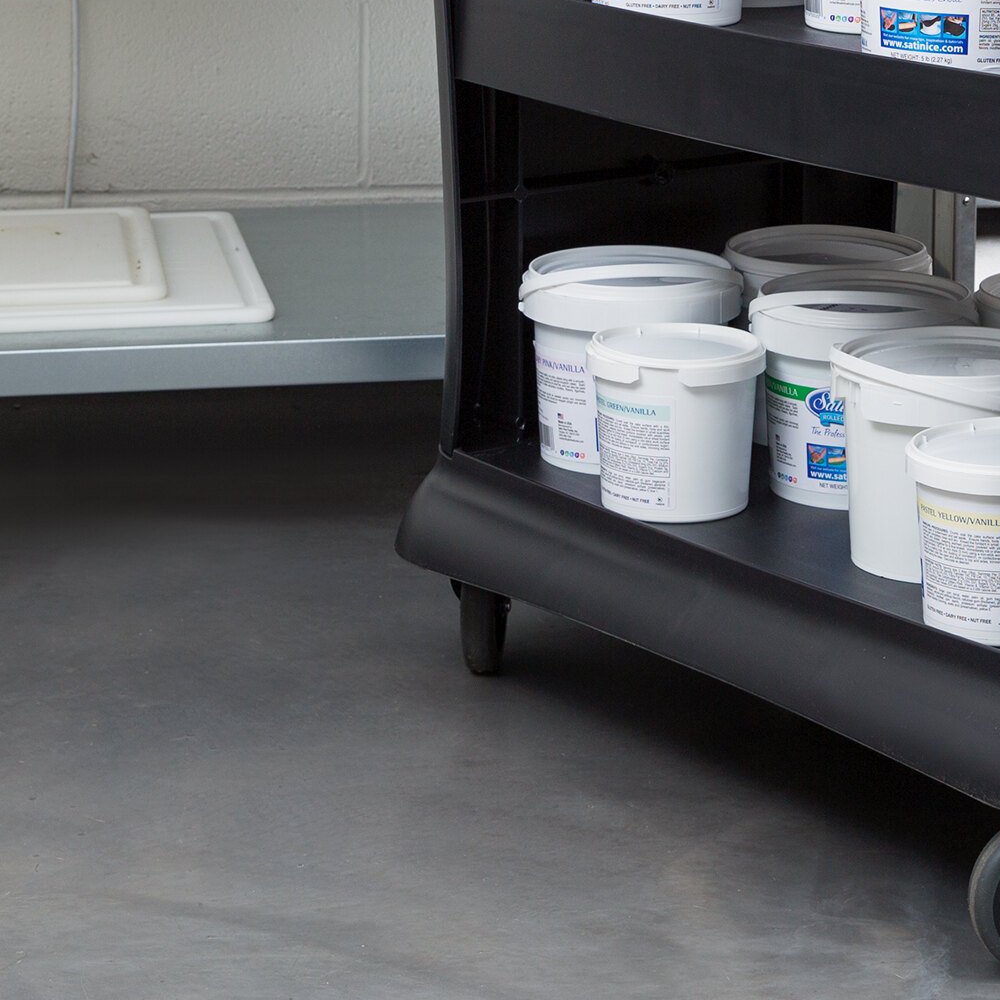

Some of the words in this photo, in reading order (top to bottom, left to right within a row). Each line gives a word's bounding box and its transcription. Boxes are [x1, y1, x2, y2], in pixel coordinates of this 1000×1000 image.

[882, 38, 964, 53] www.satinice.com
[607, 401, 657, 416] GREEN/VANILLA
[811, 426, 822, 435] The
[824, 428, 846, 439] Profess
[810, 469, 848, 481] www.sat
